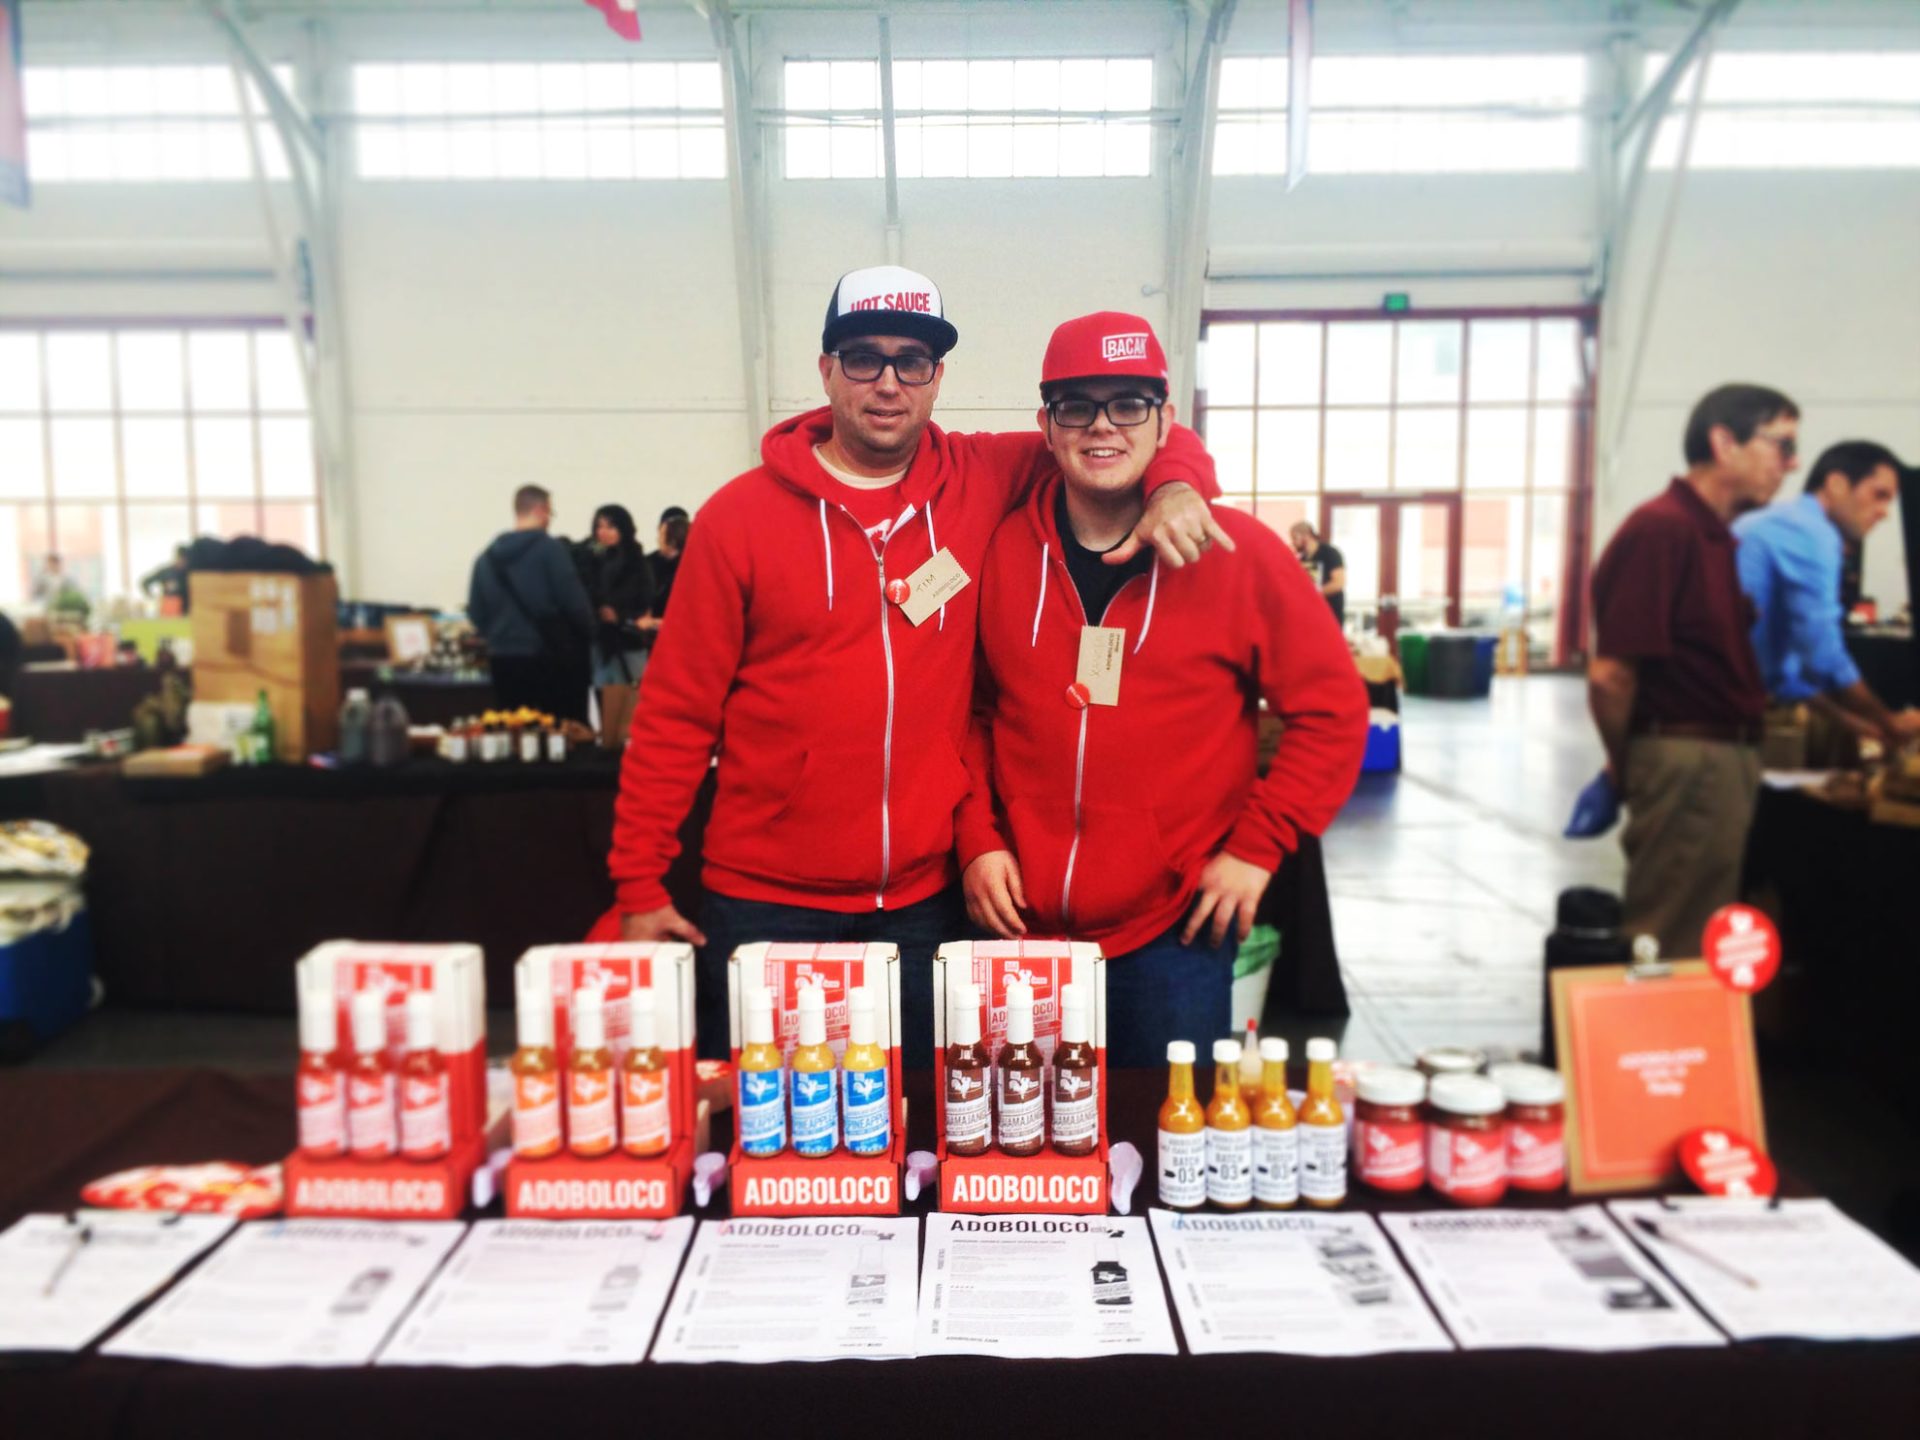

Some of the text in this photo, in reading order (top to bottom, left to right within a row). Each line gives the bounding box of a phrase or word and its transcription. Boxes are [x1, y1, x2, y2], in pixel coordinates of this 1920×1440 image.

[884, 291, 931, 312] SAUCE
[1178, 1167, 1195, 1184] 03
[296, 1178, 444, 1212] ADOBOLOCO
[518, 1179, 666, 1211] ADOBOLOCO
[744, 1176, 891, 1206] ADOBOLOCO
[952, 1175, 1099, 1204] ADOBOLOCO
[724, 1223, 862, 1237] ADOBOLOCO
[951, 1219, 1089, 1233] ADOBOLOCO
[1177, 1217, 1316, 1231] ADOBOLOCO
